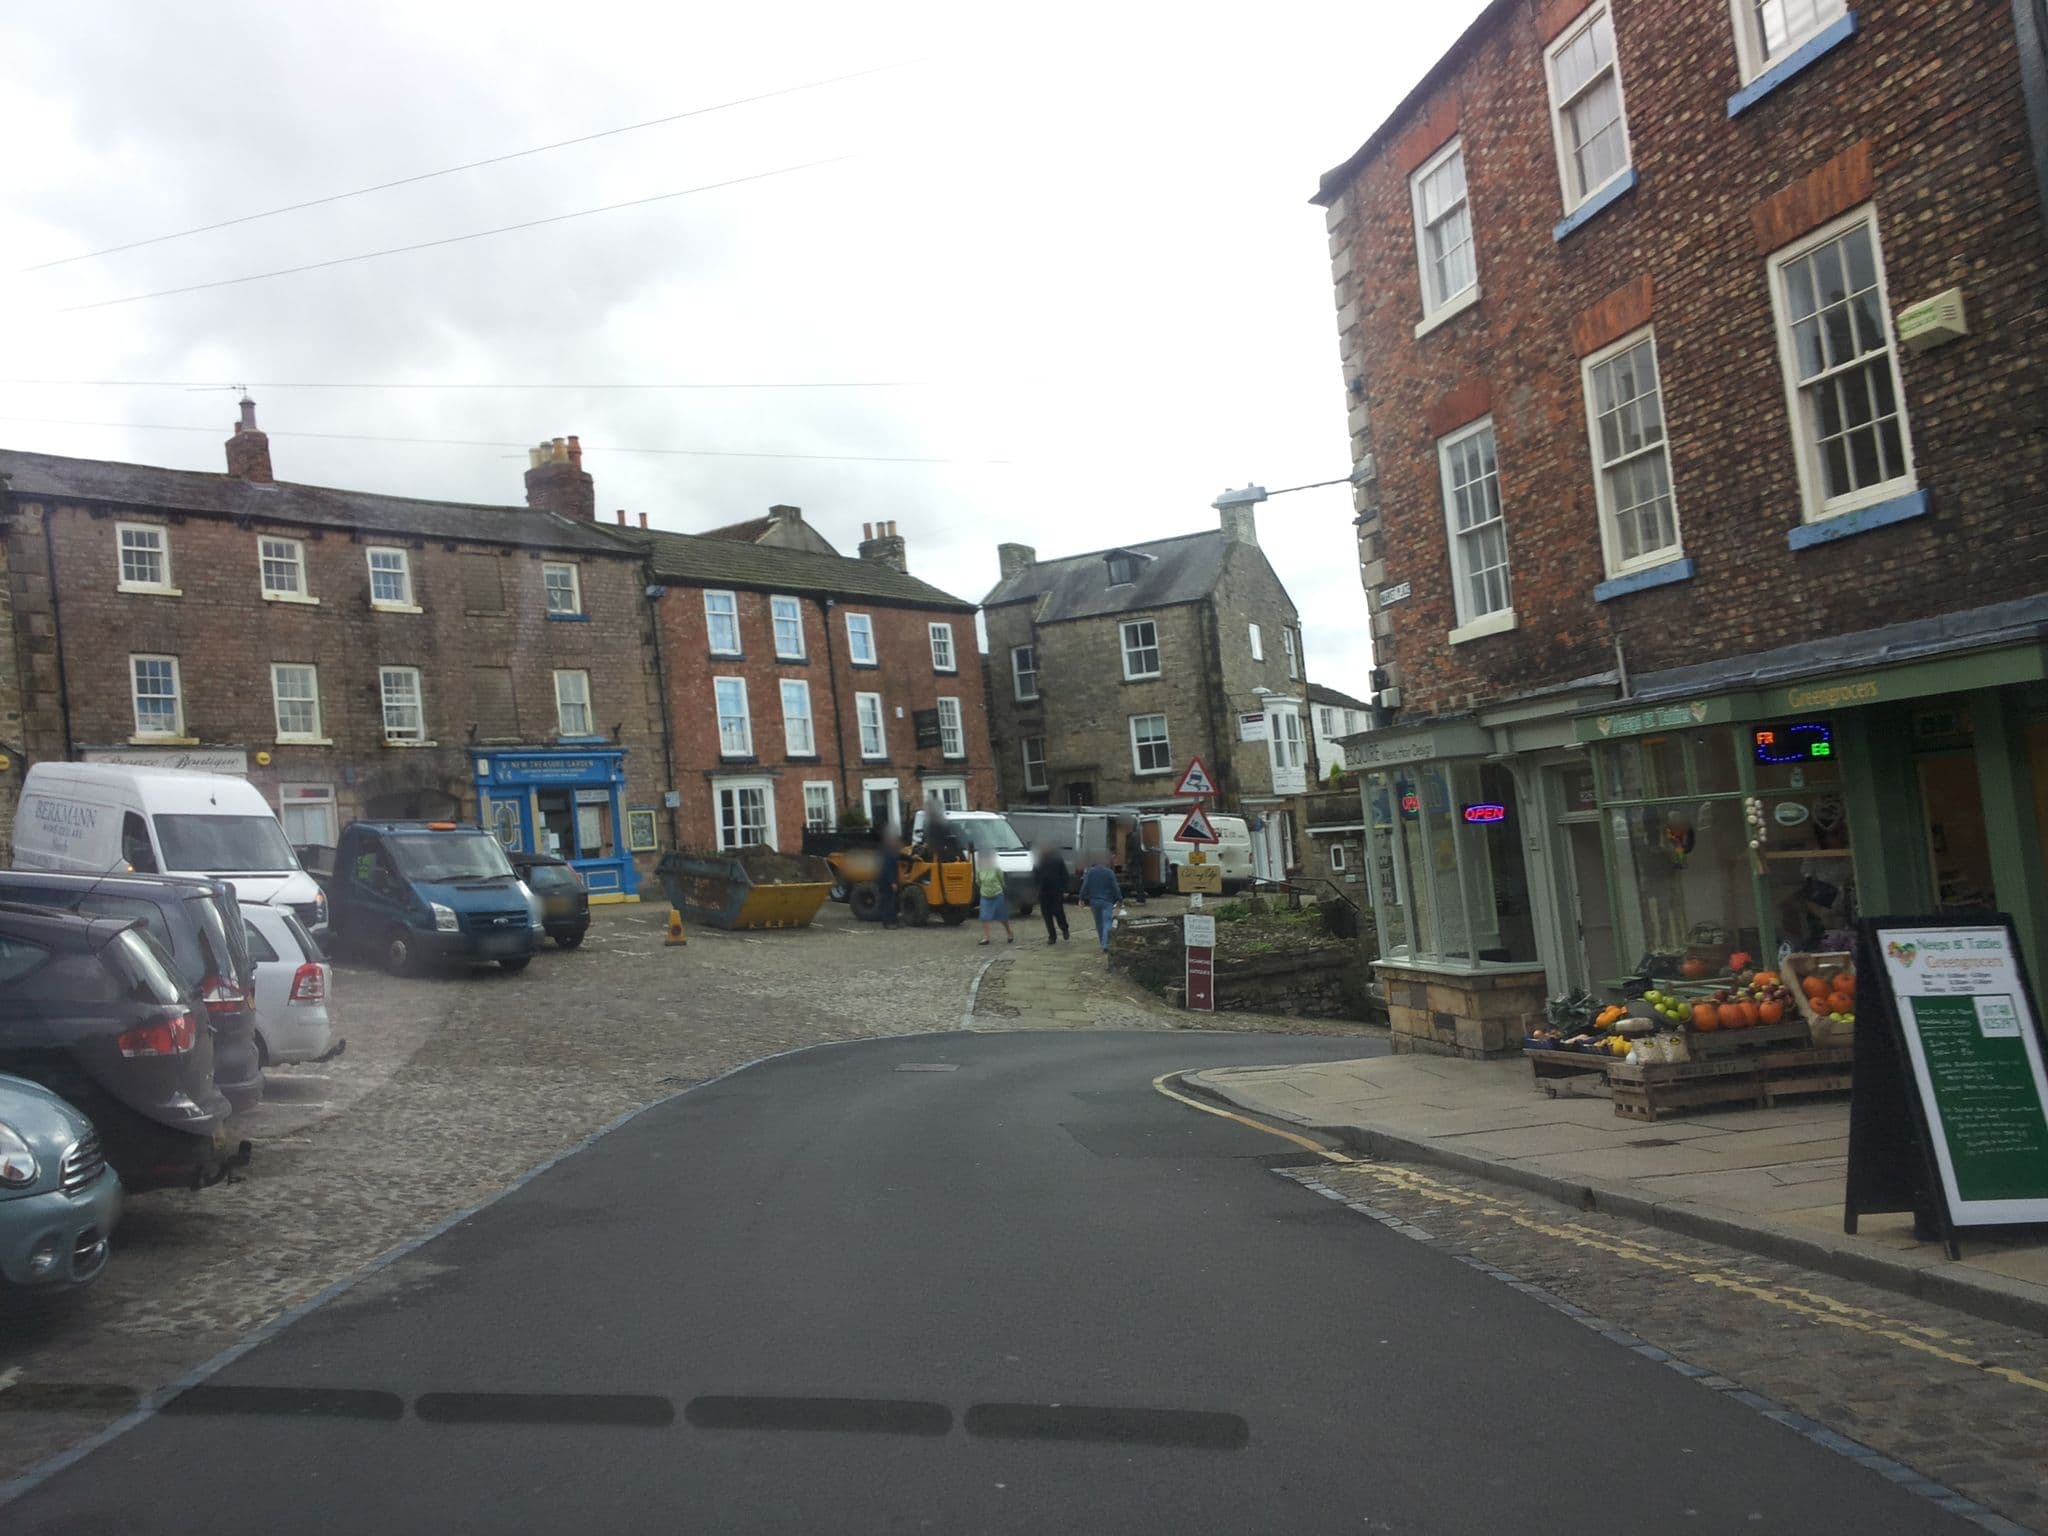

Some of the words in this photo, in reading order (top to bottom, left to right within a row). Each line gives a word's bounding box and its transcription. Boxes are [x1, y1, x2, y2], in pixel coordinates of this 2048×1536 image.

[1788, 682, 1877, 709] Greengrocers
[1757, 732, 1774, 744] FR
[1345, 743, 1380, 766] ESQUIRE
[1811, 743, 1830, 755] EG
[170, 752, 240, 769] Boutique
[35, 799, 97, 828] BERKMANN
[1465, 808, 1504, 819] OPEN
[1925, 955, 2004, 970] Greengrocers
